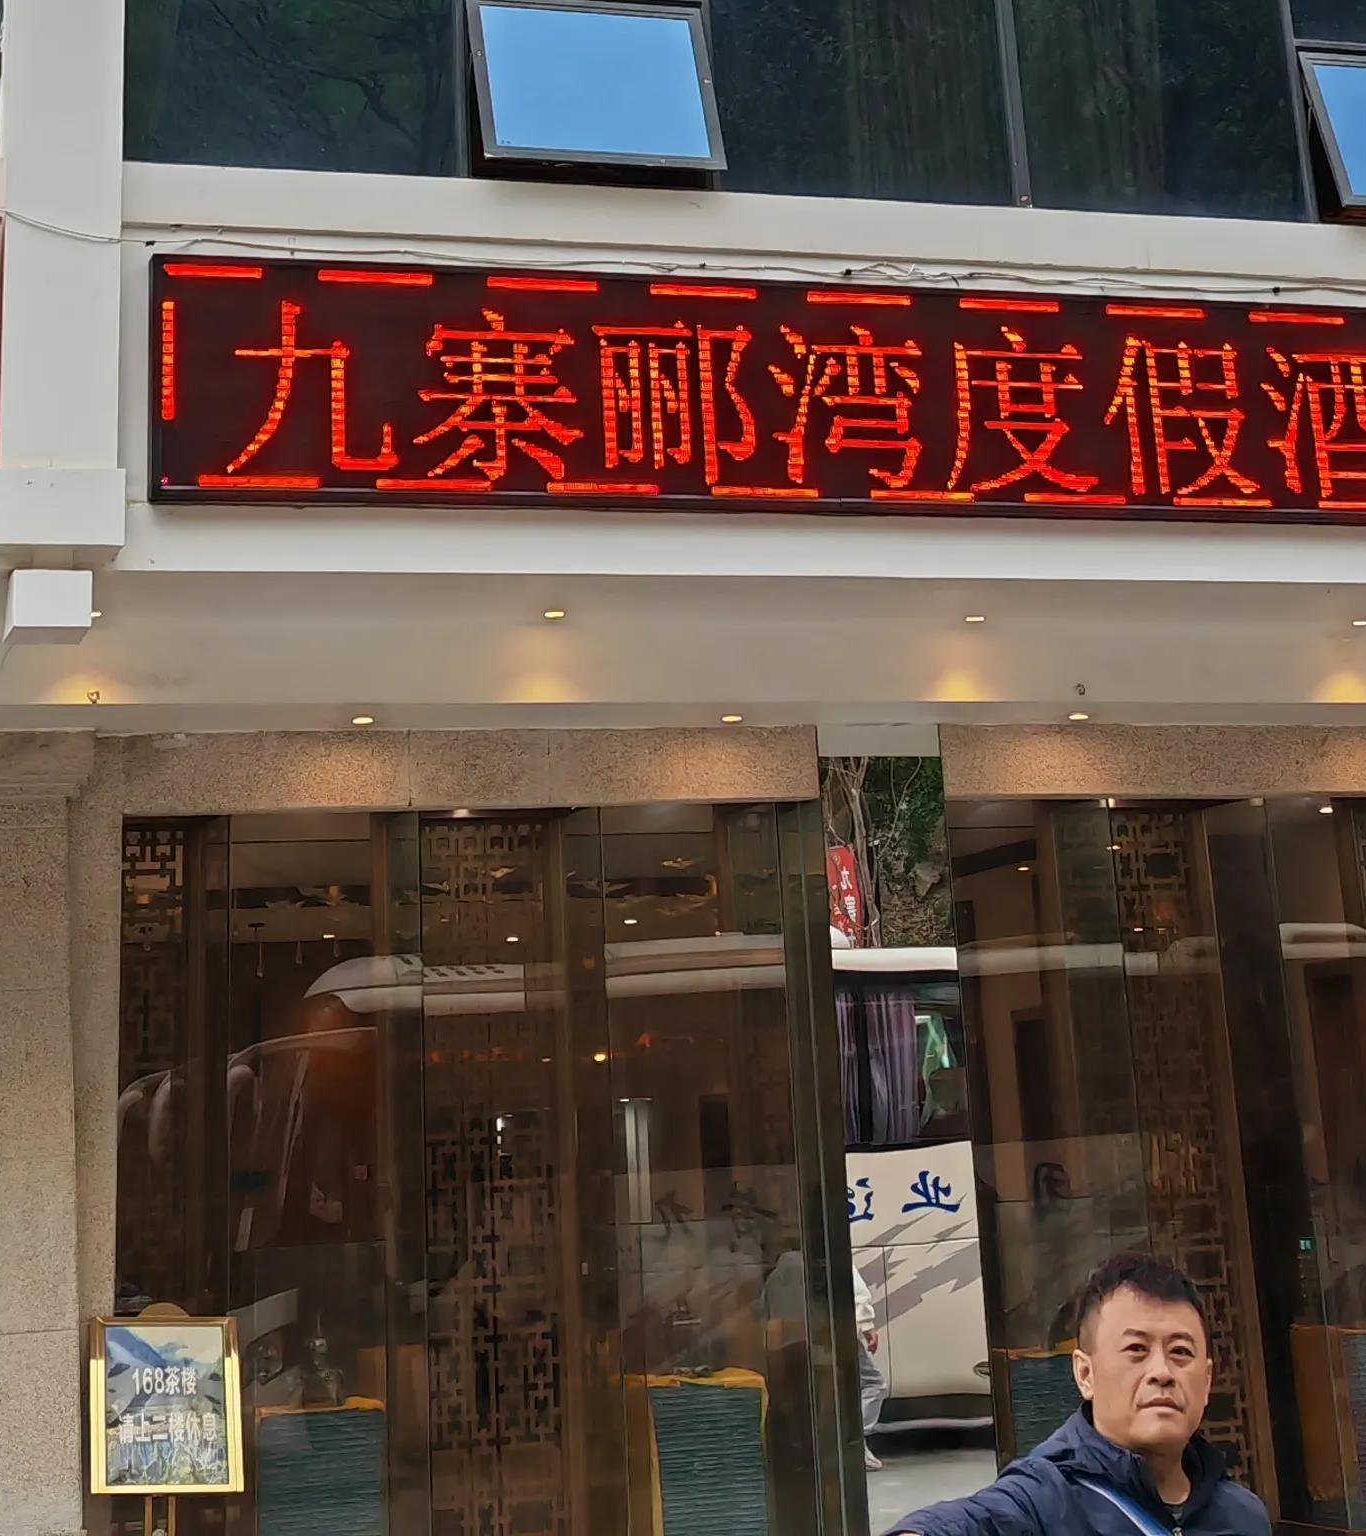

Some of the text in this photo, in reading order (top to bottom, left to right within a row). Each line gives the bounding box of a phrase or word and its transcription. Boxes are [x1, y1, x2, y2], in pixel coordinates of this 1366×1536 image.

[132, 1365, 198, 1396] 168茶楼
[119, 1410, 218, 1444] 请上二楼休息
